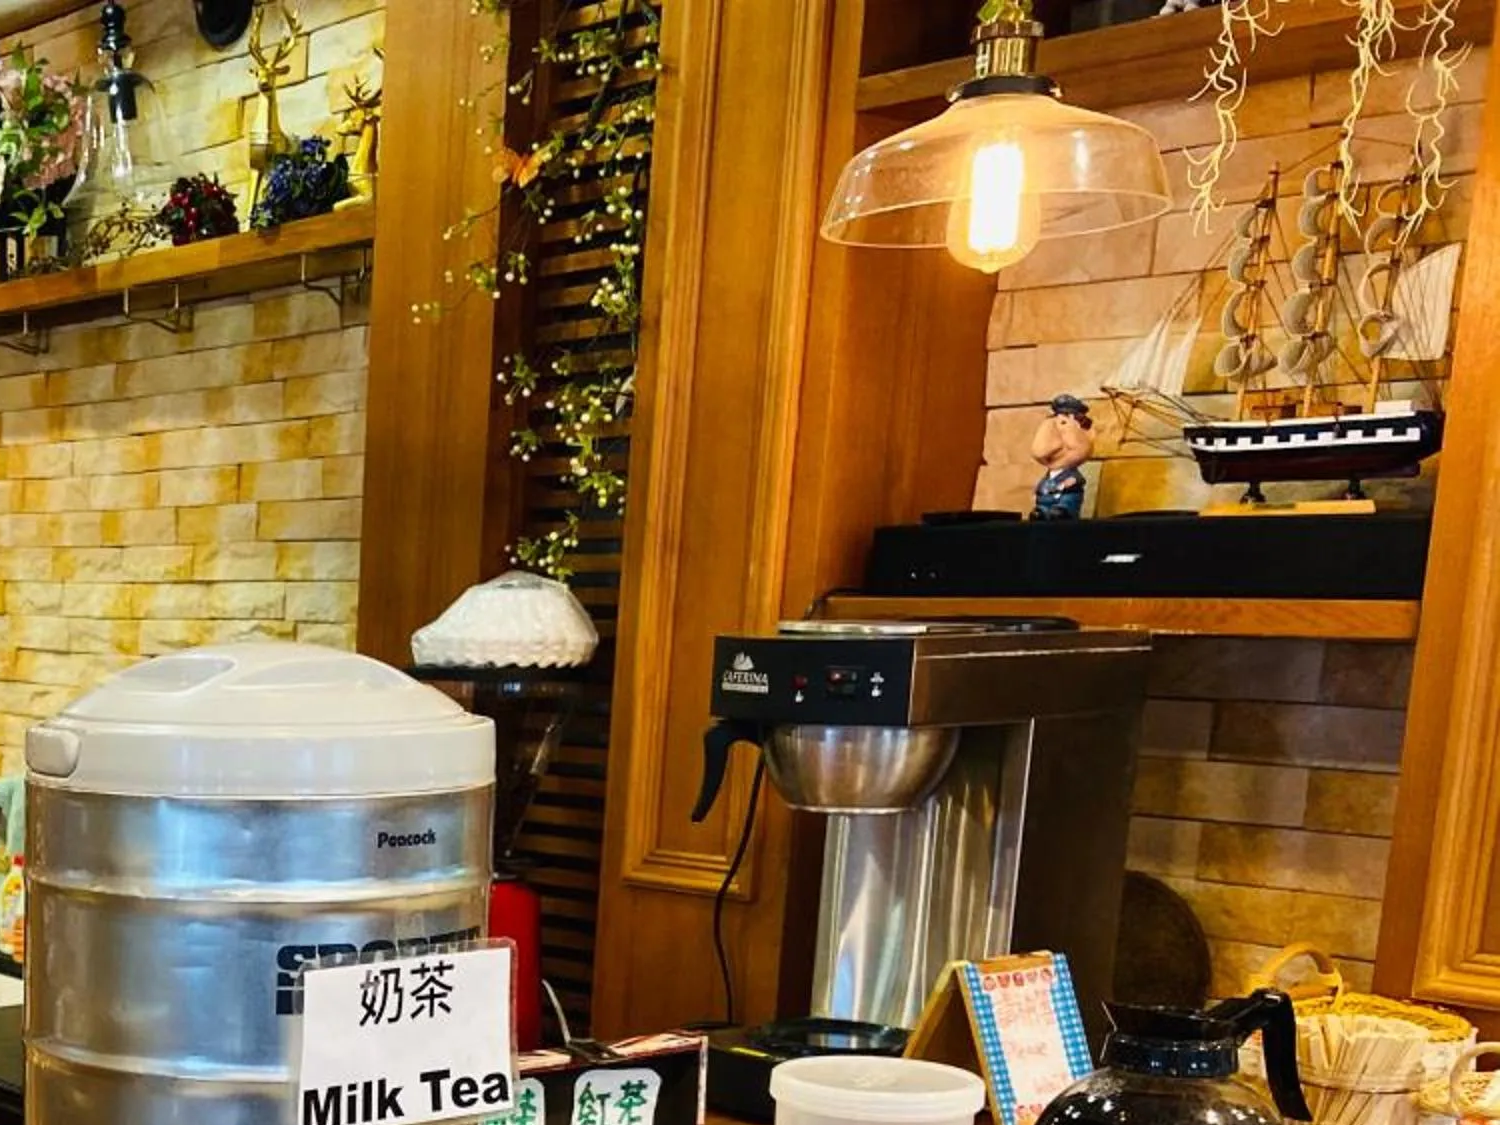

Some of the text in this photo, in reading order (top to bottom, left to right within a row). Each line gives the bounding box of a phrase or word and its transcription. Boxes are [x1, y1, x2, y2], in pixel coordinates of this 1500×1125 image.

[377, 828, 437, 849] Peacock
[359, 960, 455, 1027] 奶茶
[419, 1069, 509, 1112] Tea
